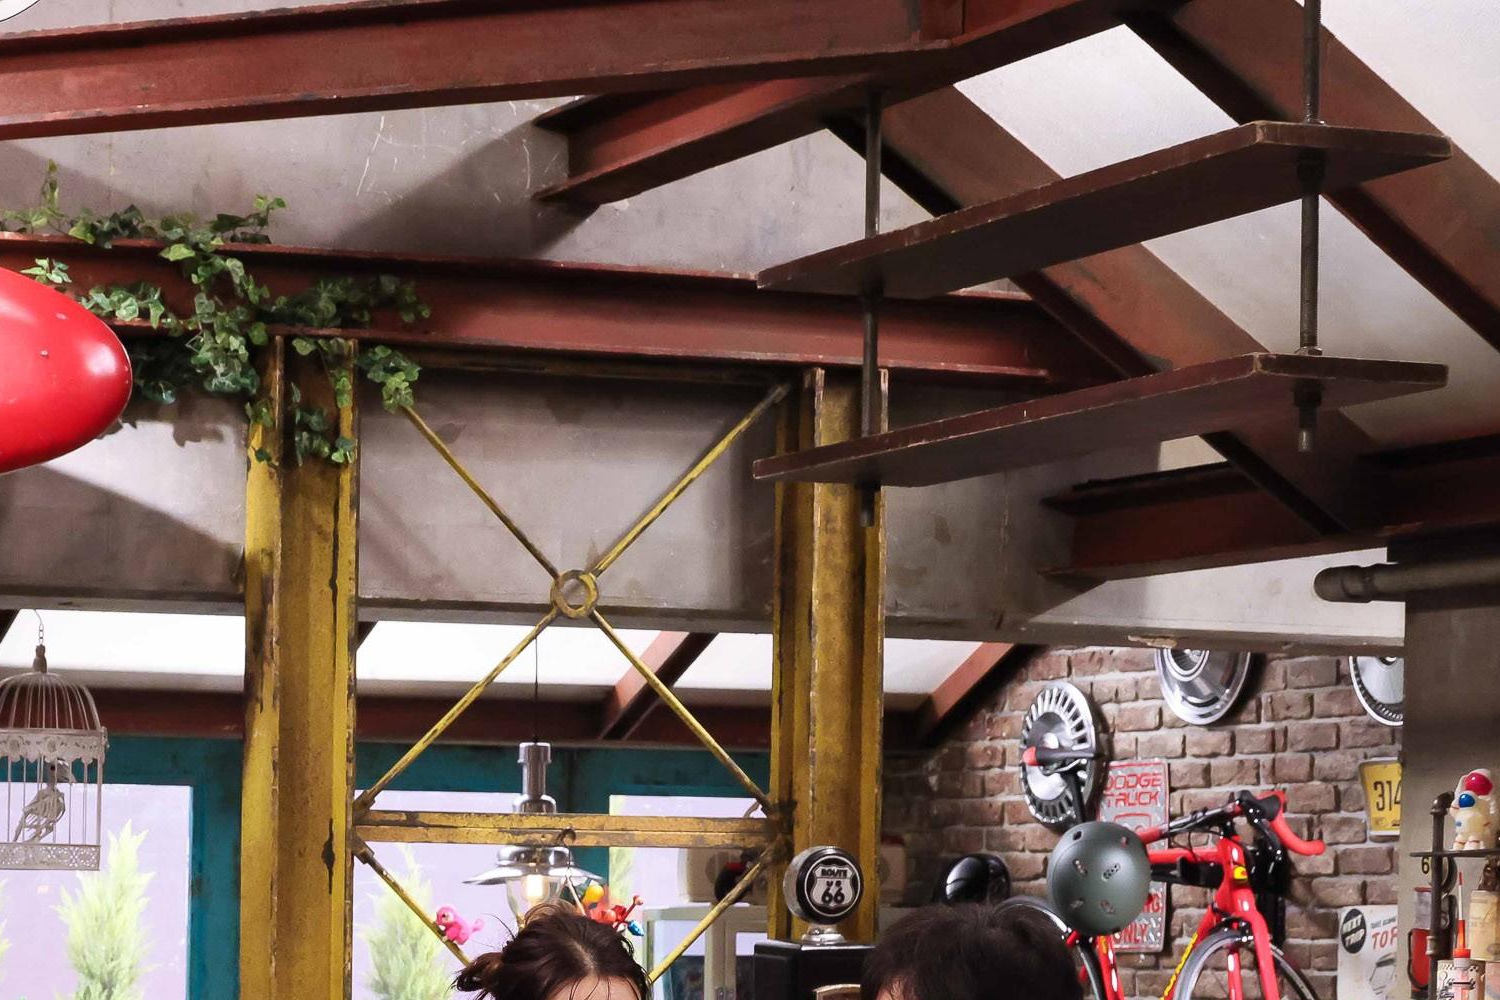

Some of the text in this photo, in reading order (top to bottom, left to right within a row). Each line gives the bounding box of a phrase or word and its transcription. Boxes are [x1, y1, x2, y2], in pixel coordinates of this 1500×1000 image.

[1104, 772, 1163, 792] DODGE
[1103, 791, 1160, 808] TRUCK
[821, 868, 848, 877] ROUTE
[821, 887, 845, 904] 66
